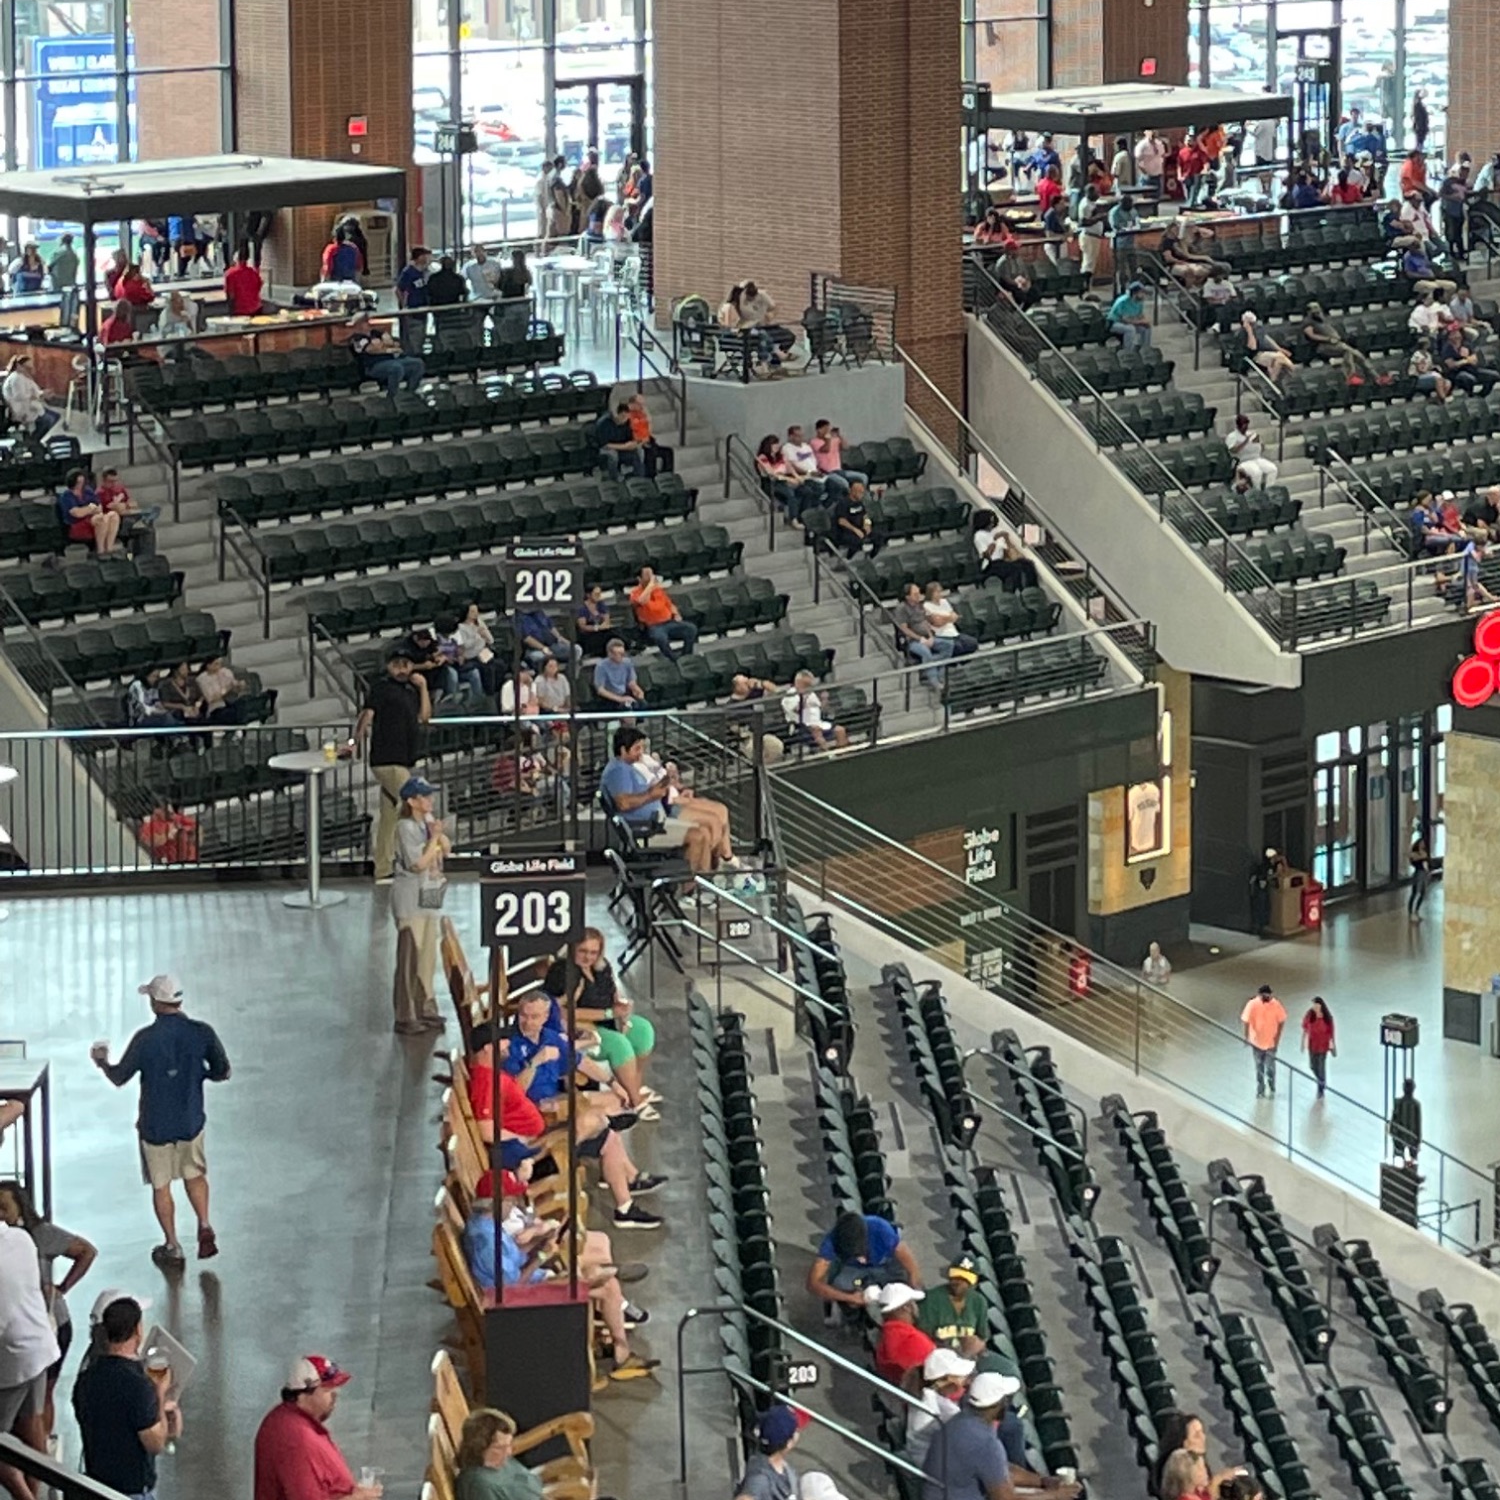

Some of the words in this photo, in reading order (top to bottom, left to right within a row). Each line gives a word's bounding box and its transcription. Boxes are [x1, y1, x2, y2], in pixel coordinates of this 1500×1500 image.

[516, 569, 572, 602] 202
[490, 860, 524, 874] Globe
[525, 859, 547, 872] Life
[547, 857, 575, 871] Field
[495, 890, 571, 936] 203
[789, 1365, 817, 1384] 203
